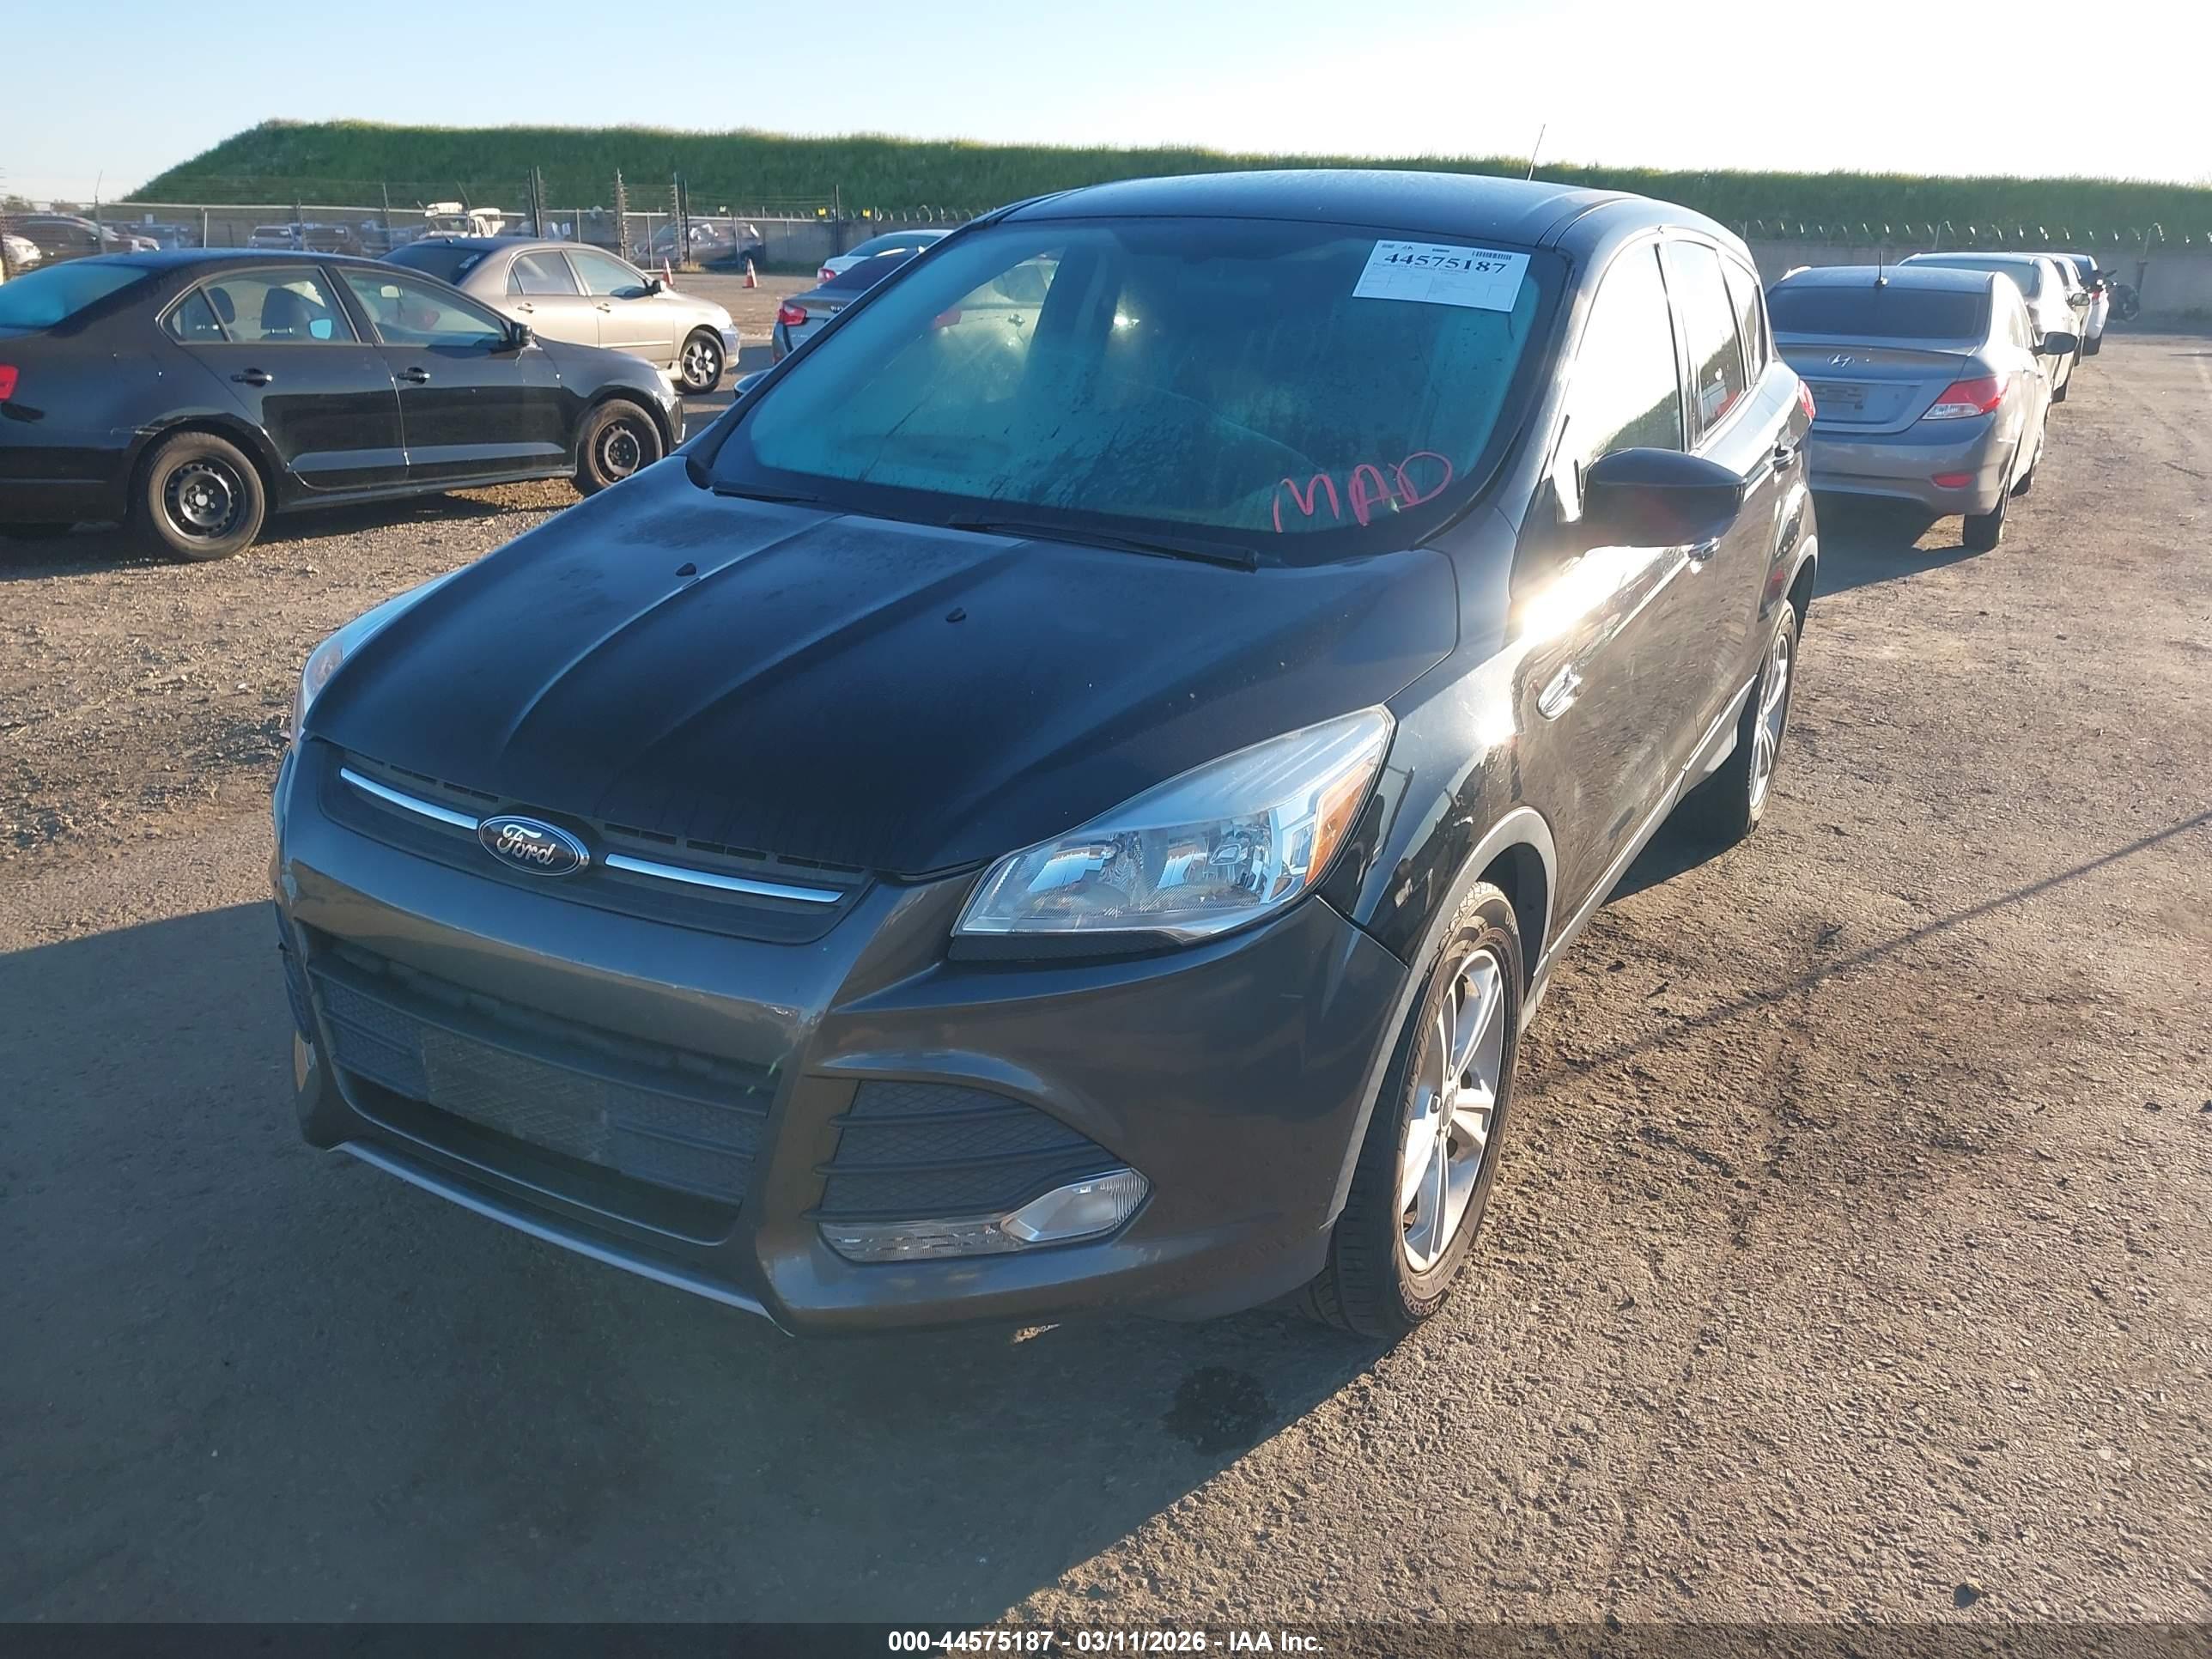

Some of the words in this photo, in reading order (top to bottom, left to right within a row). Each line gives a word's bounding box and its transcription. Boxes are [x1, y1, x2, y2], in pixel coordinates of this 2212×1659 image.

[1383, 252, 1507, 275] 44575187
[1273, 451, 1453, 534] MAD
[495, 823, 556, 866] Ford
